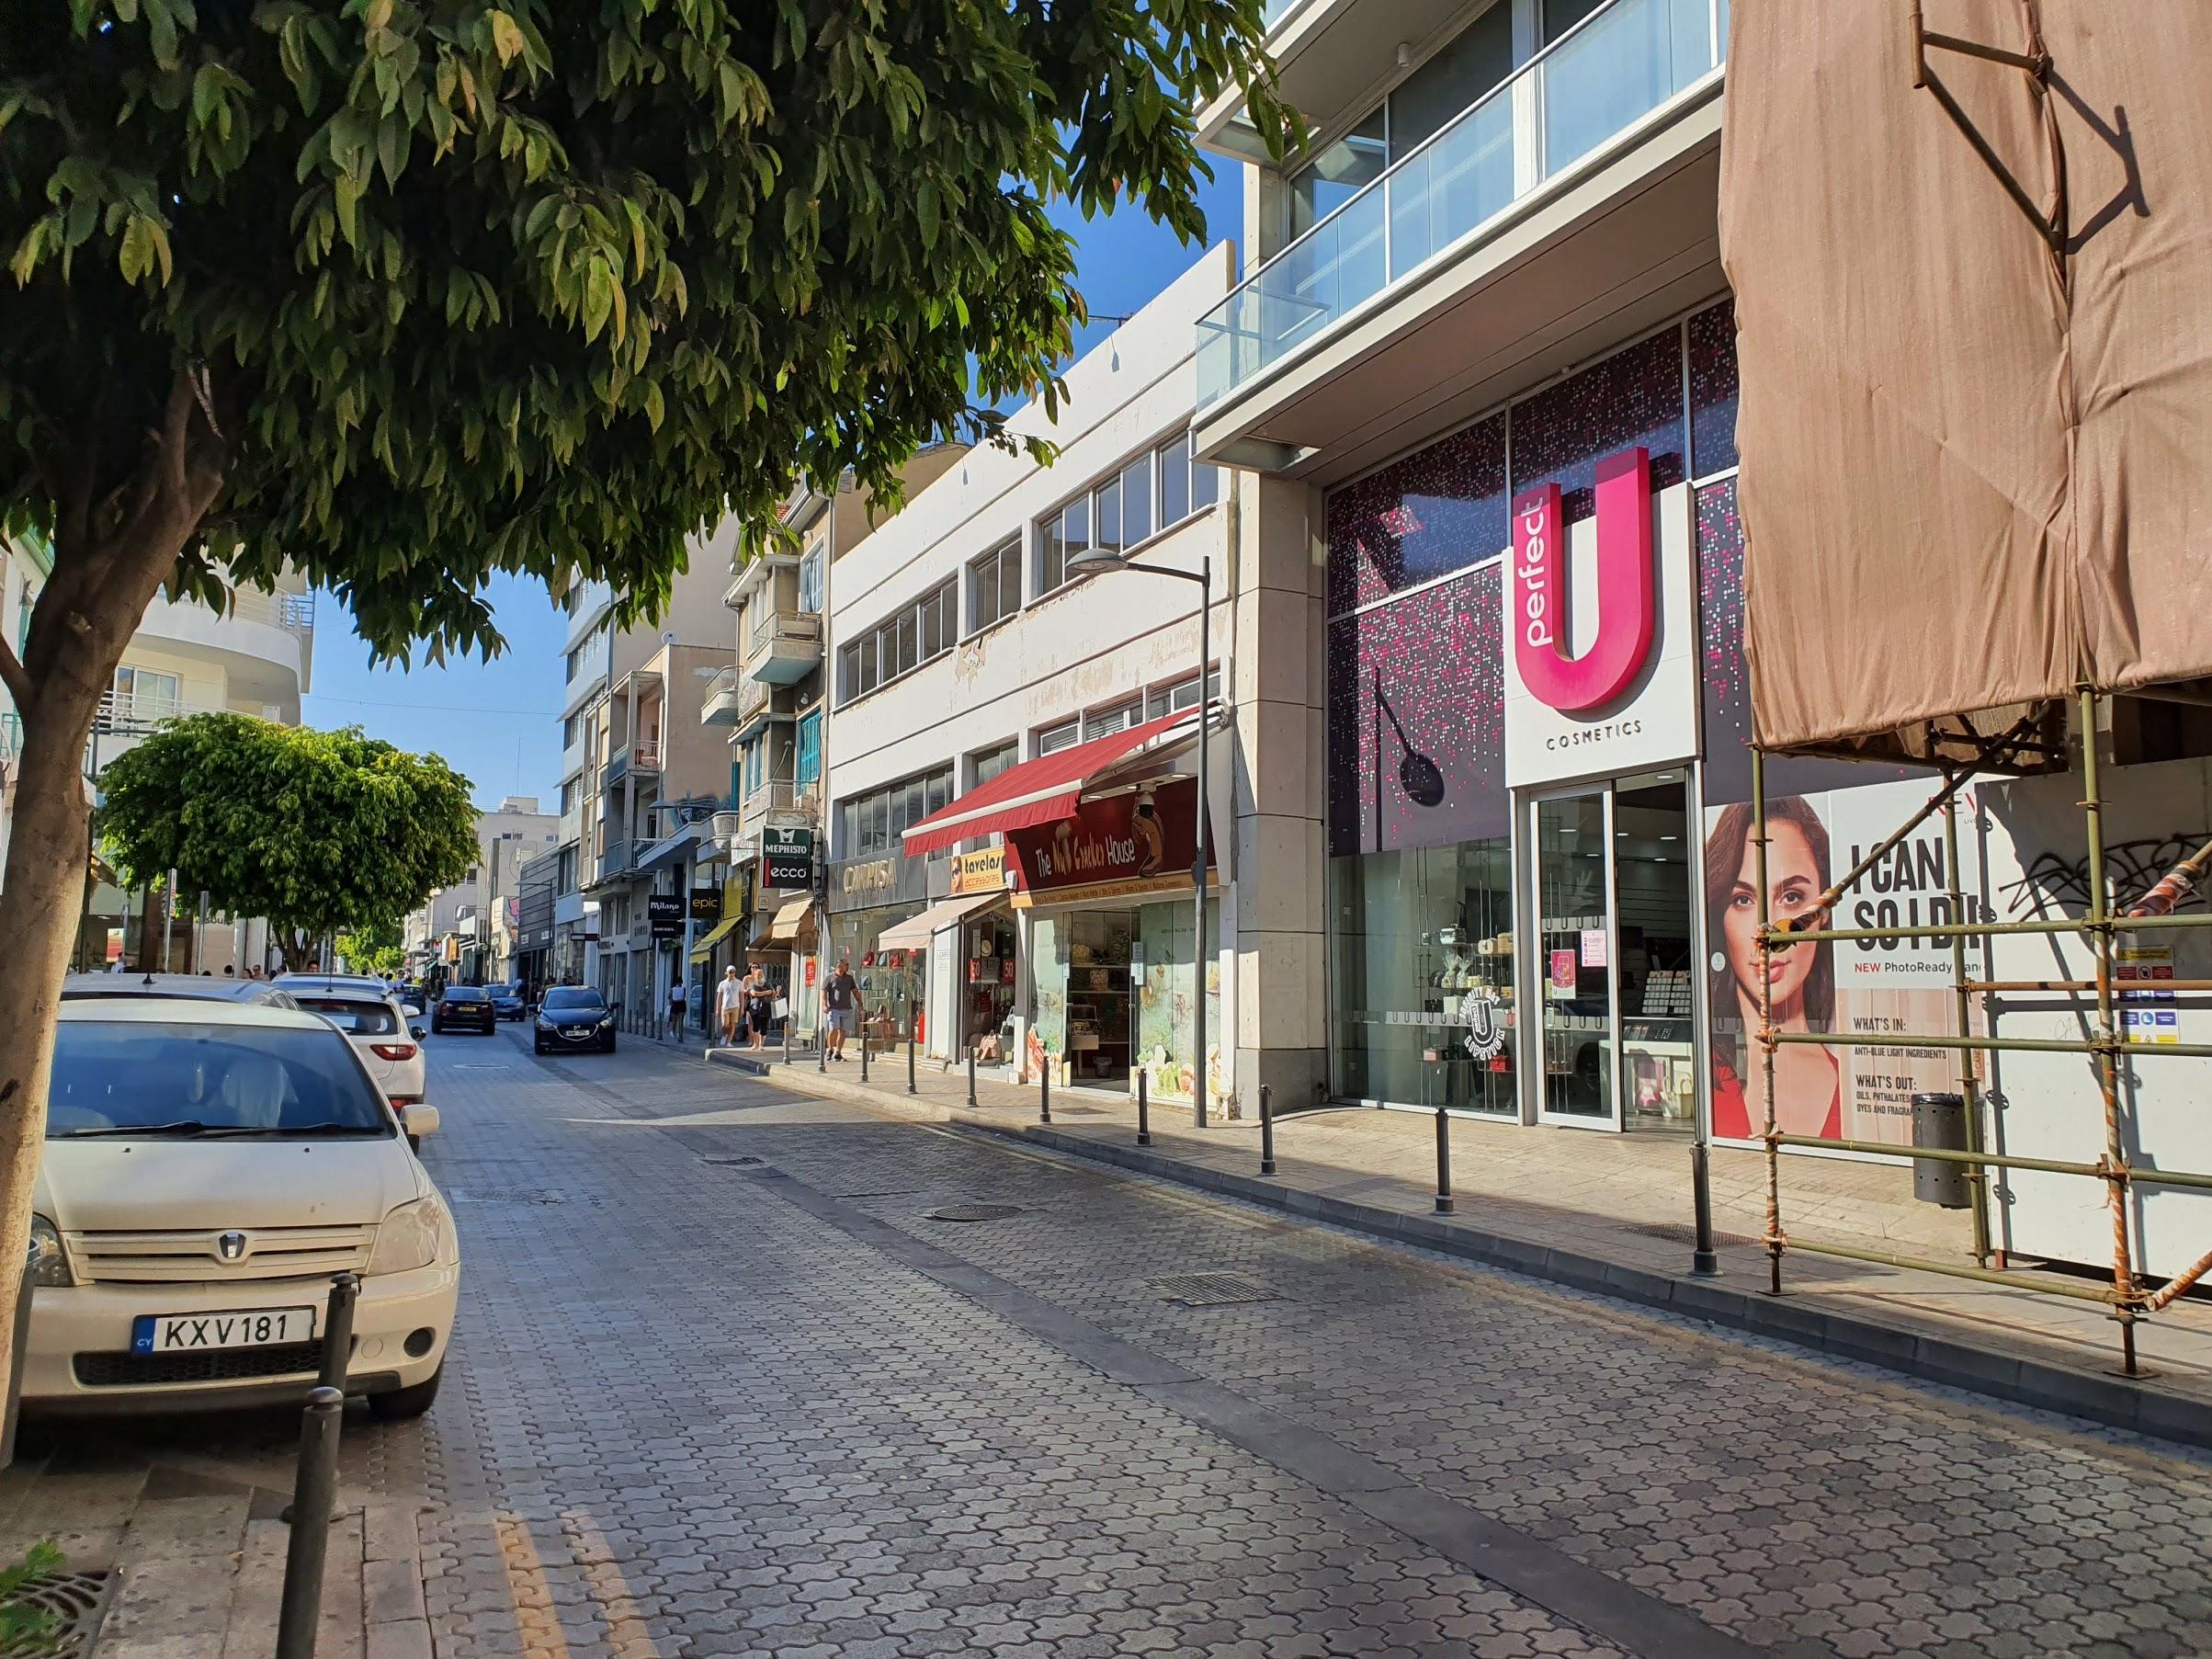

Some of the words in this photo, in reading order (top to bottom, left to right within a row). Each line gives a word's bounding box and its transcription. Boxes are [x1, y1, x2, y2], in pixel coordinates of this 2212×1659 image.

[1513, 446, 1654, 710] U
[1518, 497, 1553, 647] perfect
[1546, 720, 1642, 751] COSMETICS
[765, 844, 808, 855] MEPHISTO
[1035, 847, 1052, 879] The
[1106, 834, 1136, 866] House
[770, 867, 807, 879] ecco
[1851, 845, 1862, 894] I
[650, 902, 680, 910] Milano
[692, 897, 719, 909] epic
[1855, 899, 1900, 951] SO
[1909, 898, 1920, 949] I
[1004, 961, 1014, 978] 50
[1855, 962, 1881, 972] NEW
[1885, 961, 1953, 974] PhotoReady
[1853, 1017, 1889, 1031] WHAT'S
[1892, 1017, 1907, 1031] IN:
[1464, 1028, 1505, 1061] LIPSTICK
[1854, 1047, 1885, 1056] ANTI-BLUE
[1887, 1048, 1903, 1057] LIGHT
[1905, 1049, 1947, 1060] INGREDIENTS
[1855, 1074, 1892, 1088] WHAT'S
[1895, 1076, 1917, 1091] OUT:
[1872, 1091, 1911, 1103] PHTHALATES
[1856, 1104, 1872, 1113] DYES
[1873, 1105, 1886, 1114] AND
[137, 1338, 152, 1347] CY
